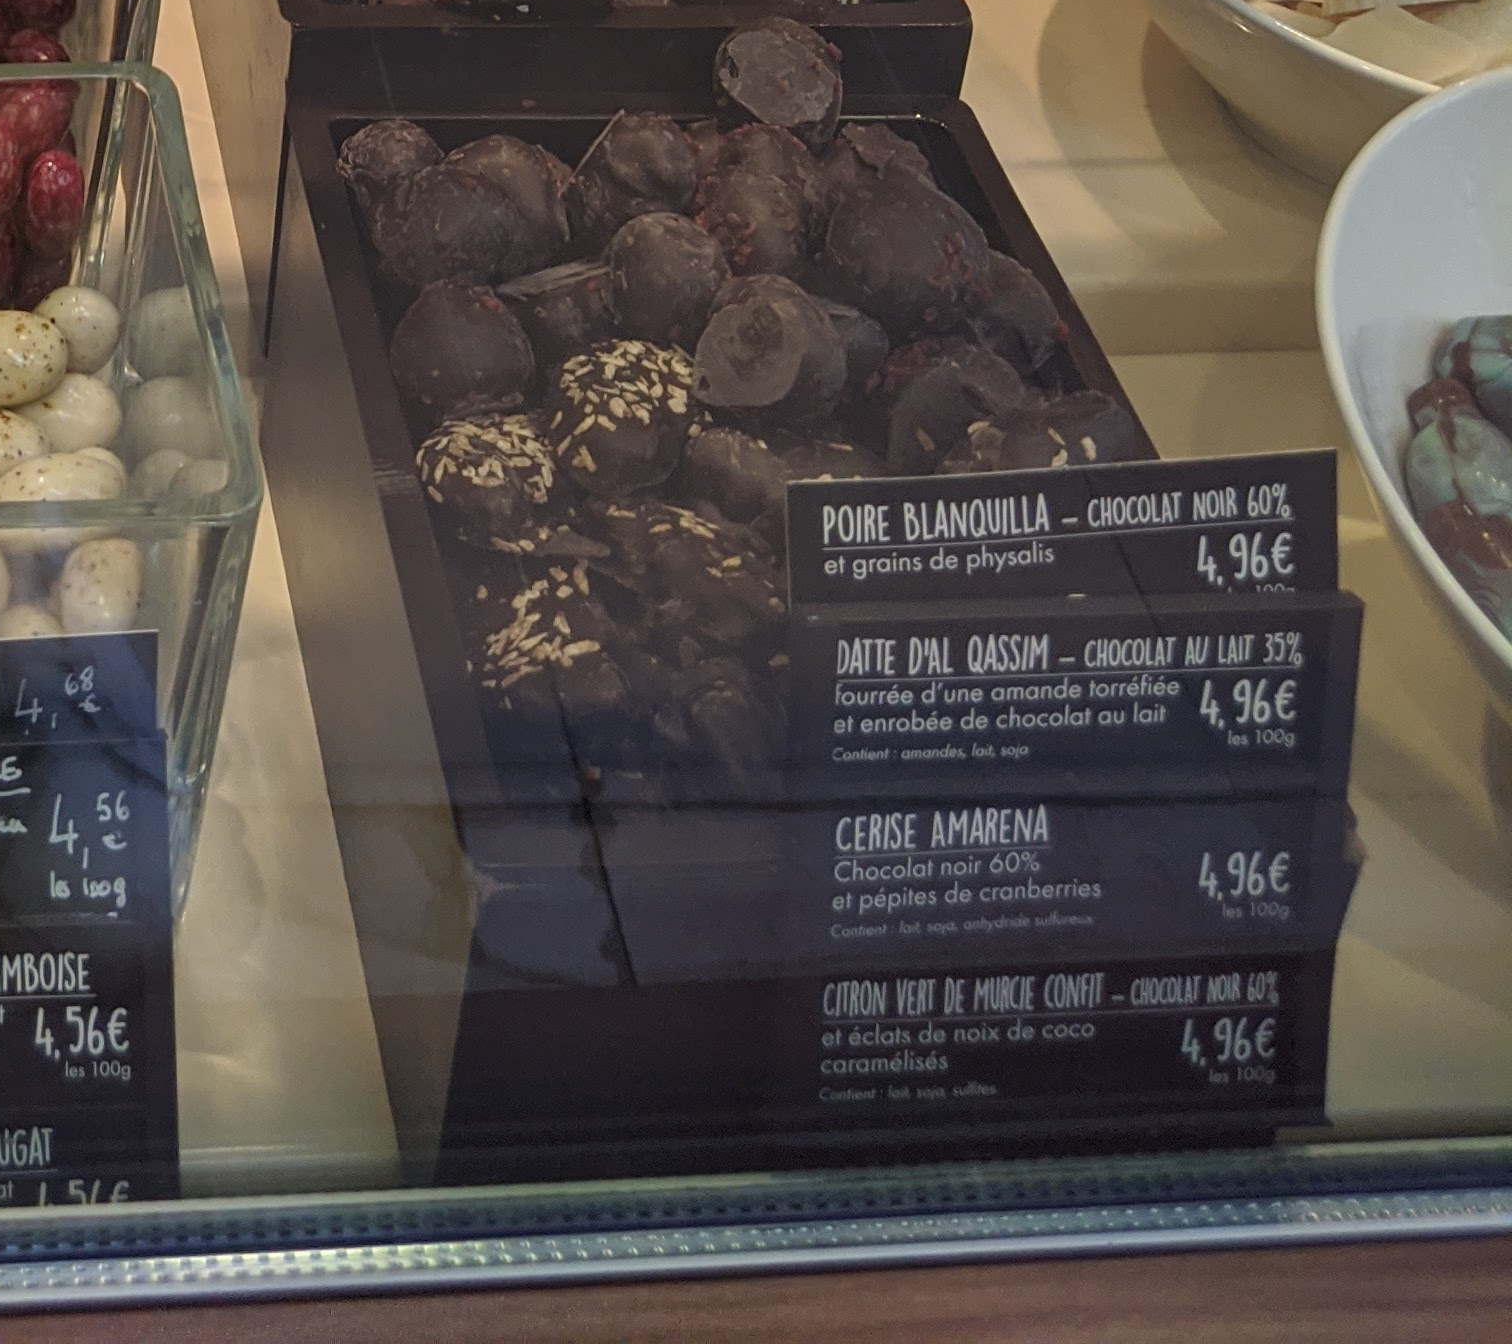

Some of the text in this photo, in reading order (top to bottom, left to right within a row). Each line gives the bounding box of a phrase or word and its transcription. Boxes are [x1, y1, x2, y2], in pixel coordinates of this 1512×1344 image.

[822, 481, 1291, 545] POIRE BLANQUILLA CHOCOLAT NOIR 60%
[824, 542, 1055, 580] et grains de physalis
[835, 630, 1304, 677] DATTE D'AL QASSIM CHOCOLAT AU LAIT 35%
[921, 680, 983, 704] d'une
[990, 677, 1083, 701] amande
[1088, 672, 1181, 699] torréfiée
[833, 702, 1167, 735] et enrobée de chocolat au lait
[1226, 727, 1296, 748] les 100g
[835, 804, 1050, 853] CERISE AMARENA
[833, 851, 1041, 882] Chocolat noir 60%
[832, 877, 1103, 915] et pépites de cranberries
[823, 970, 1280, 1017] CITRON VERT DE MURCIE CONFIT CHOCOLAT NOIR 60%
[821, 1018, 1095, 1048] et éclats de noix de coco
[65, 1059, 131, 1080] les 100g
[820, 1051, 949, 1075] caramélisés
